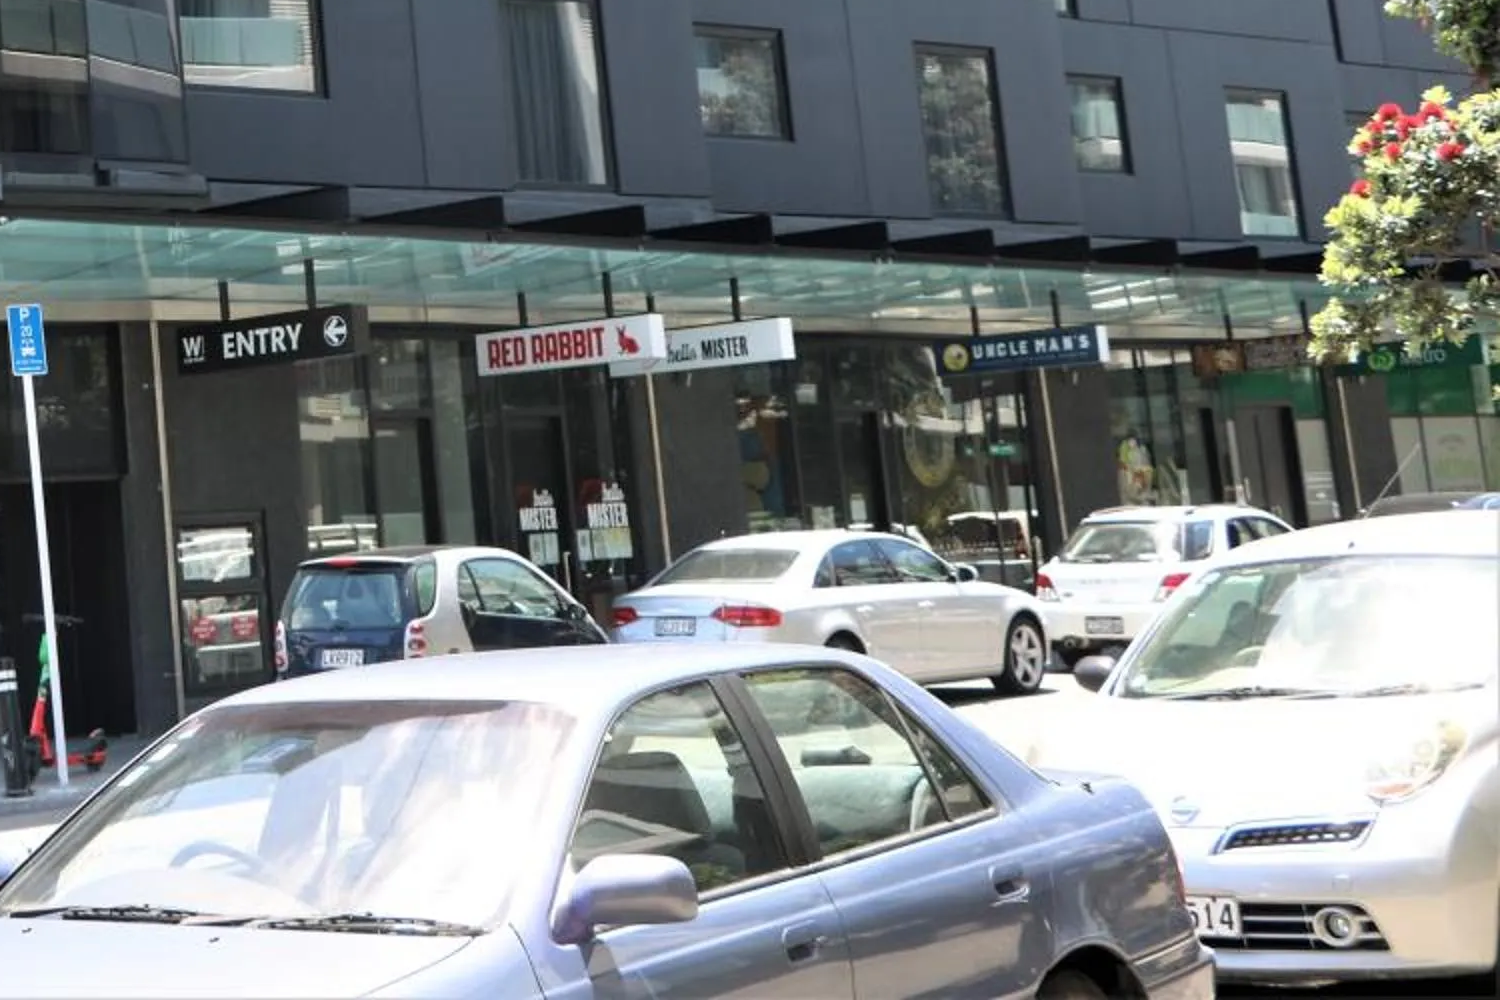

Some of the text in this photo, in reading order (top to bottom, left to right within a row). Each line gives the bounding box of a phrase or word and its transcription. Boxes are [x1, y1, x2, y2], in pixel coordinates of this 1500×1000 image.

[19, 307, 30, 322] P
[222, 323, 303, 360] ENTRY
[487, 327, 605, 369] RED RABBIT
[701, 335, 749, 360] MISTER
[972, 340, 1029, 360] UNCLE
[1034, 333, 1090, 353] MAN'S
